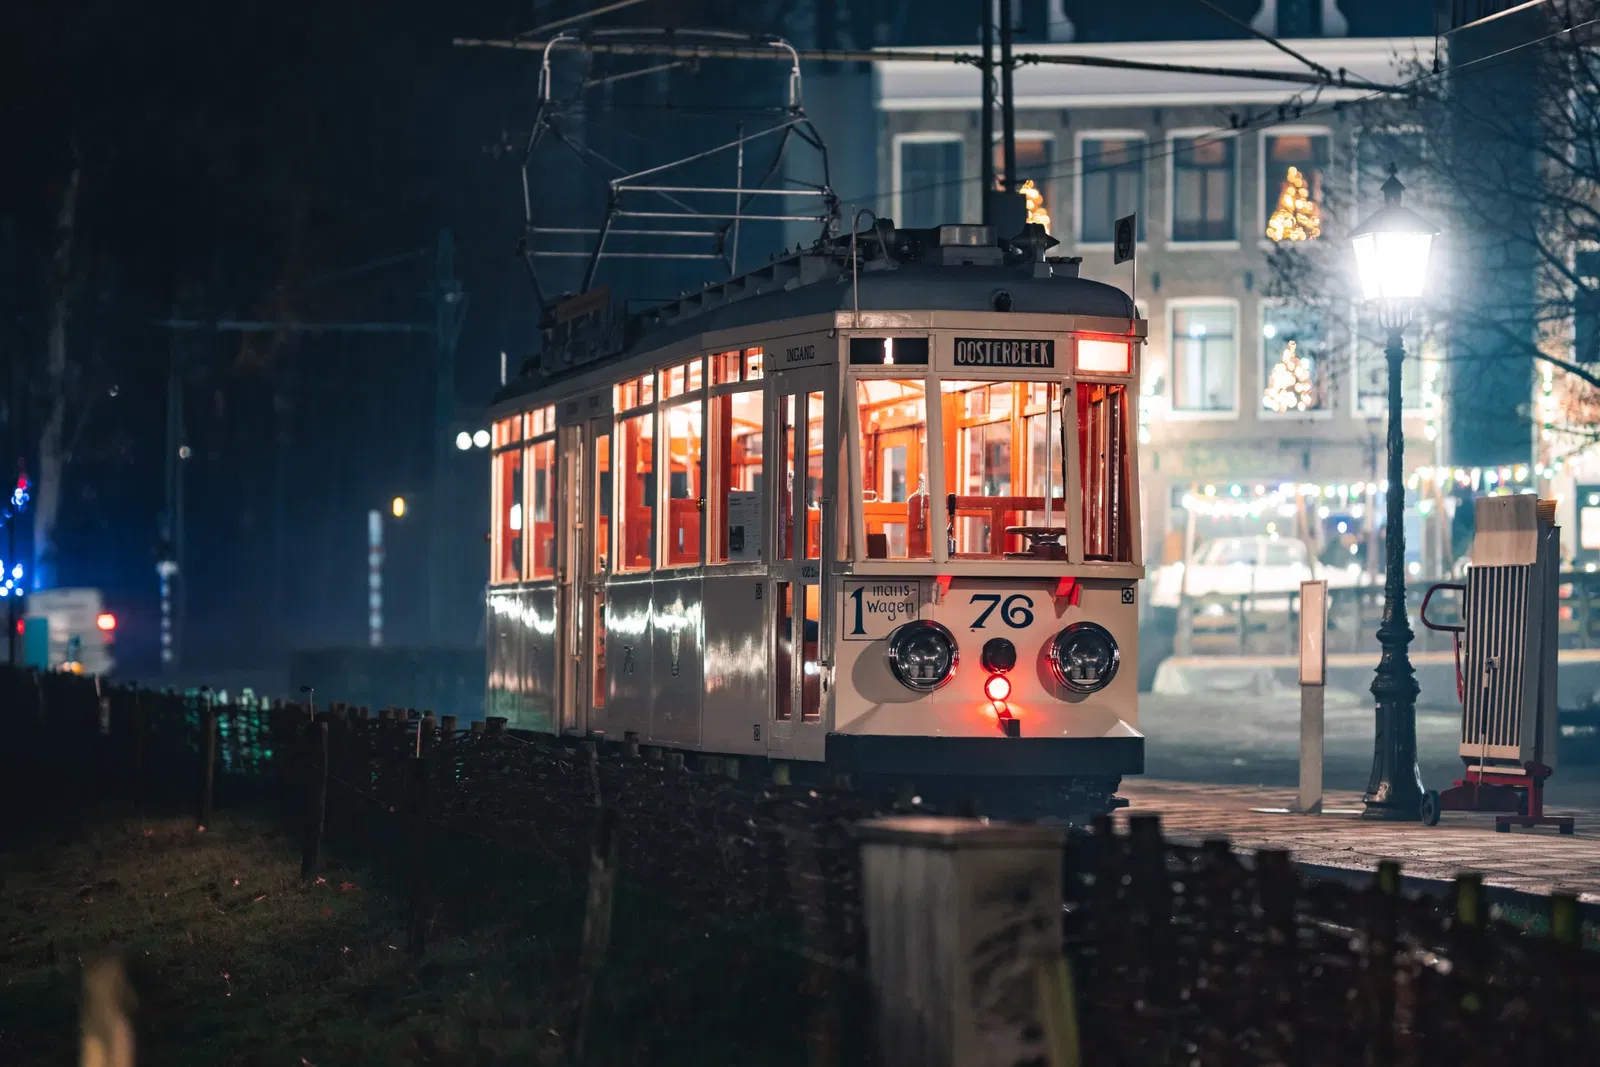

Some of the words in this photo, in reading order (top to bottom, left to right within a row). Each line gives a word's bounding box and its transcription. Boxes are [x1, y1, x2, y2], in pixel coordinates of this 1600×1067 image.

[787, 344, 815, 363] INGANG
[884, 337, 894, 365] 1
[957, 341, 1049, 365] OOSTERBEEK
[850, 586, 869, 635] 1
[969, 594, 1034, 630] 76
